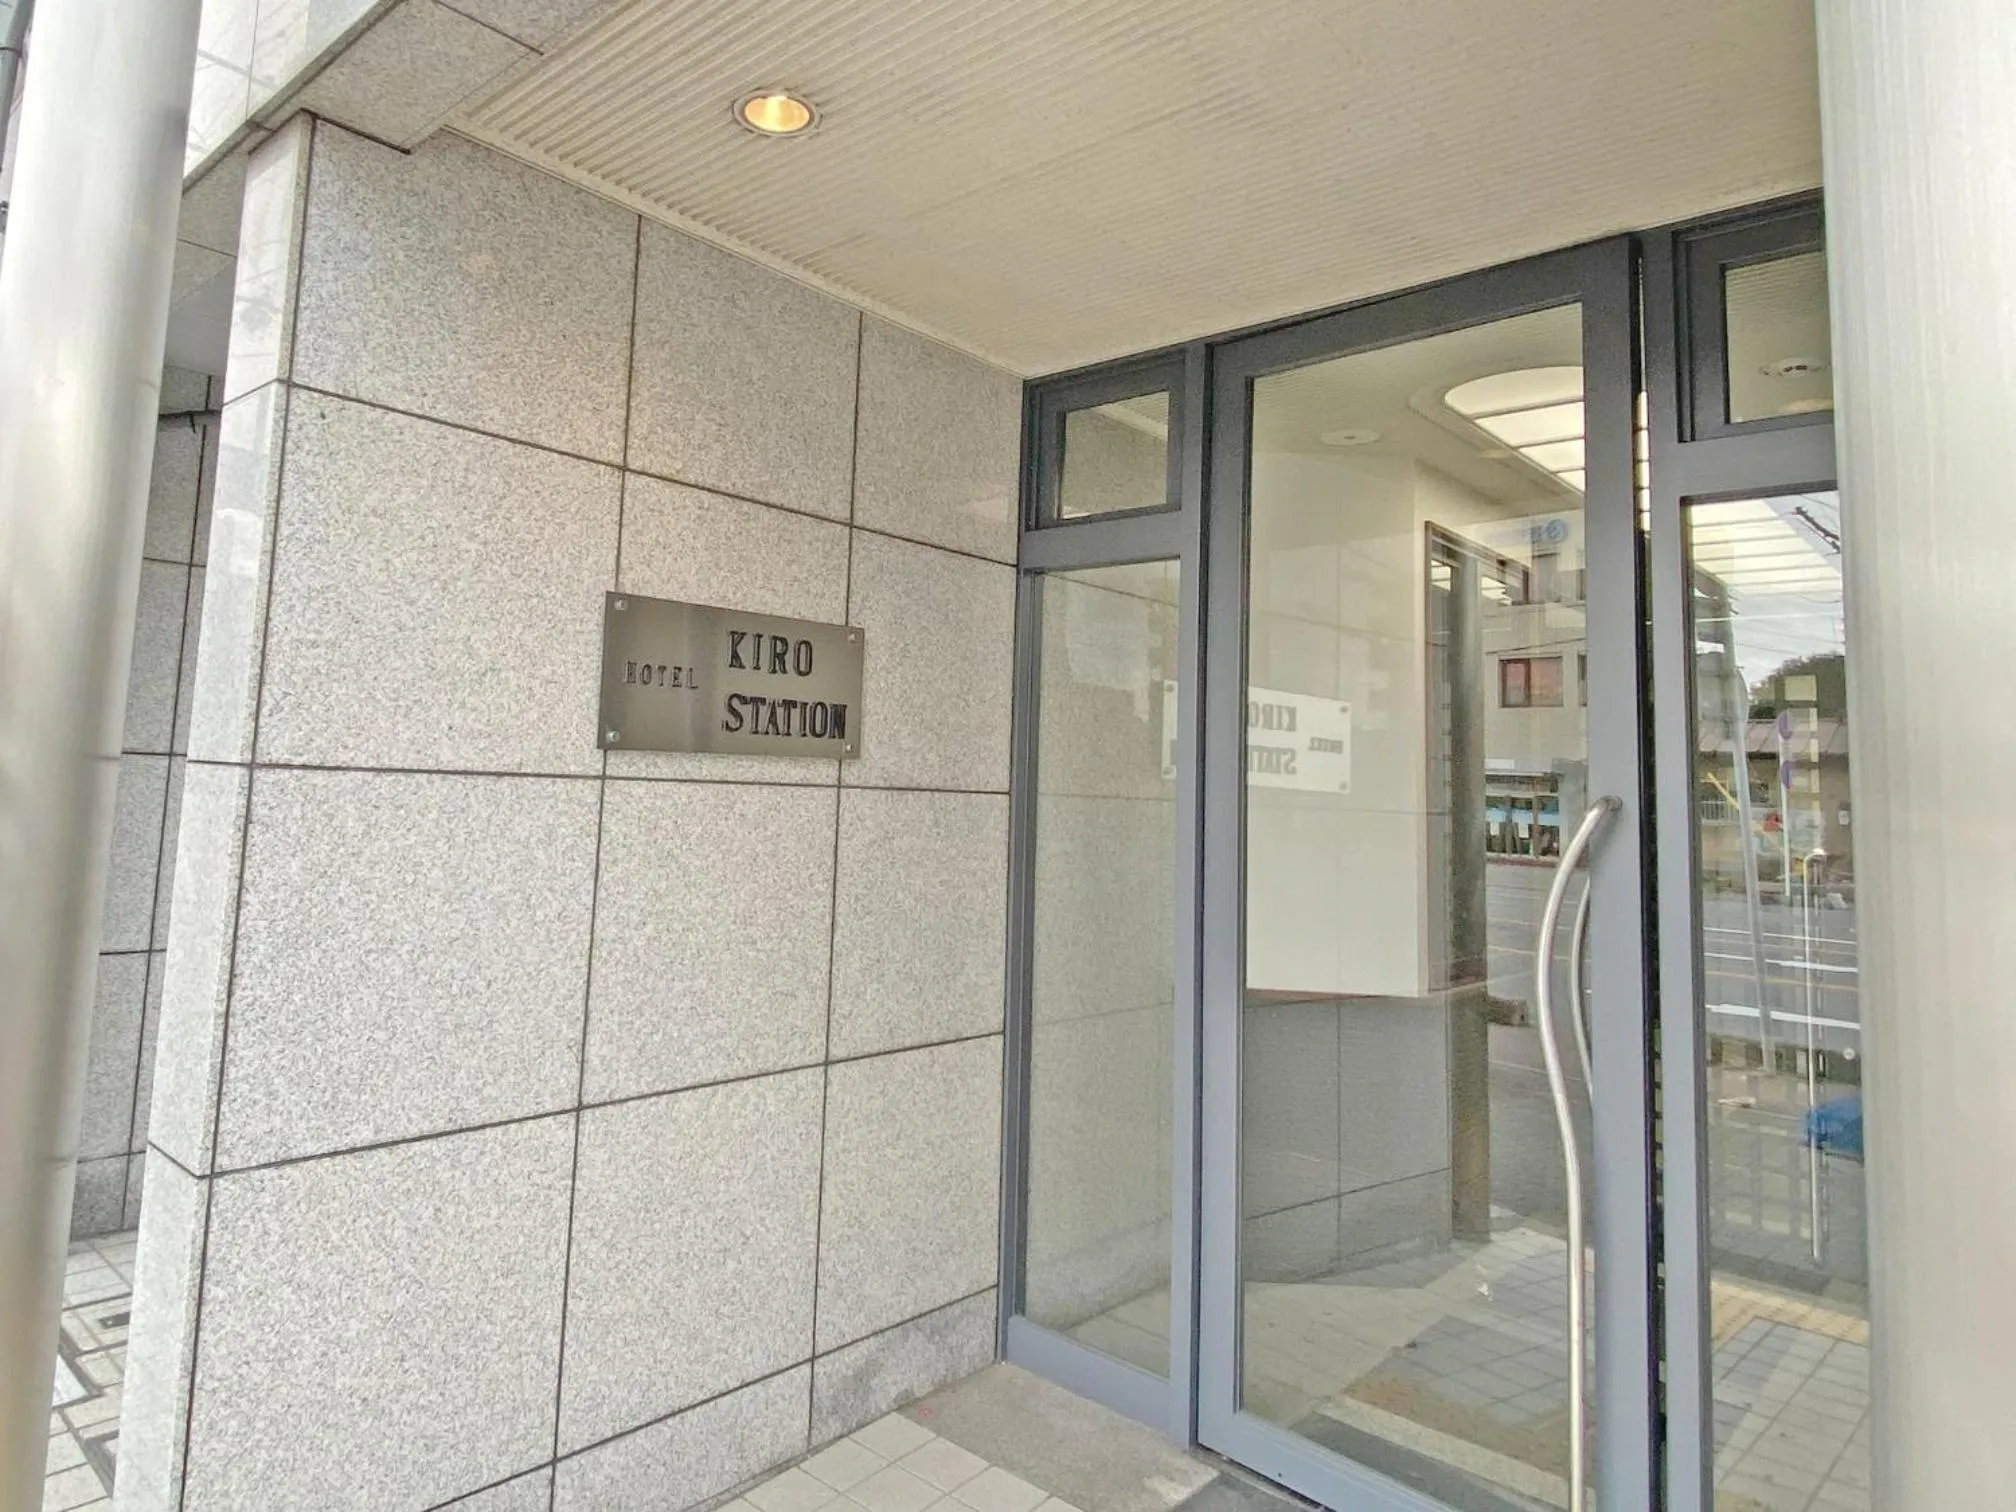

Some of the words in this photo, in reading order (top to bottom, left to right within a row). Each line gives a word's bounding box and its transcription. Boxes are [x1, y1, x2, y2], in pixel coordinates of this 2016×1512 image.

[625, 660, 699, 689] HOTEL
[728, 630, 813, 677] KIRO
[722, 692, 848, 739] STATION
